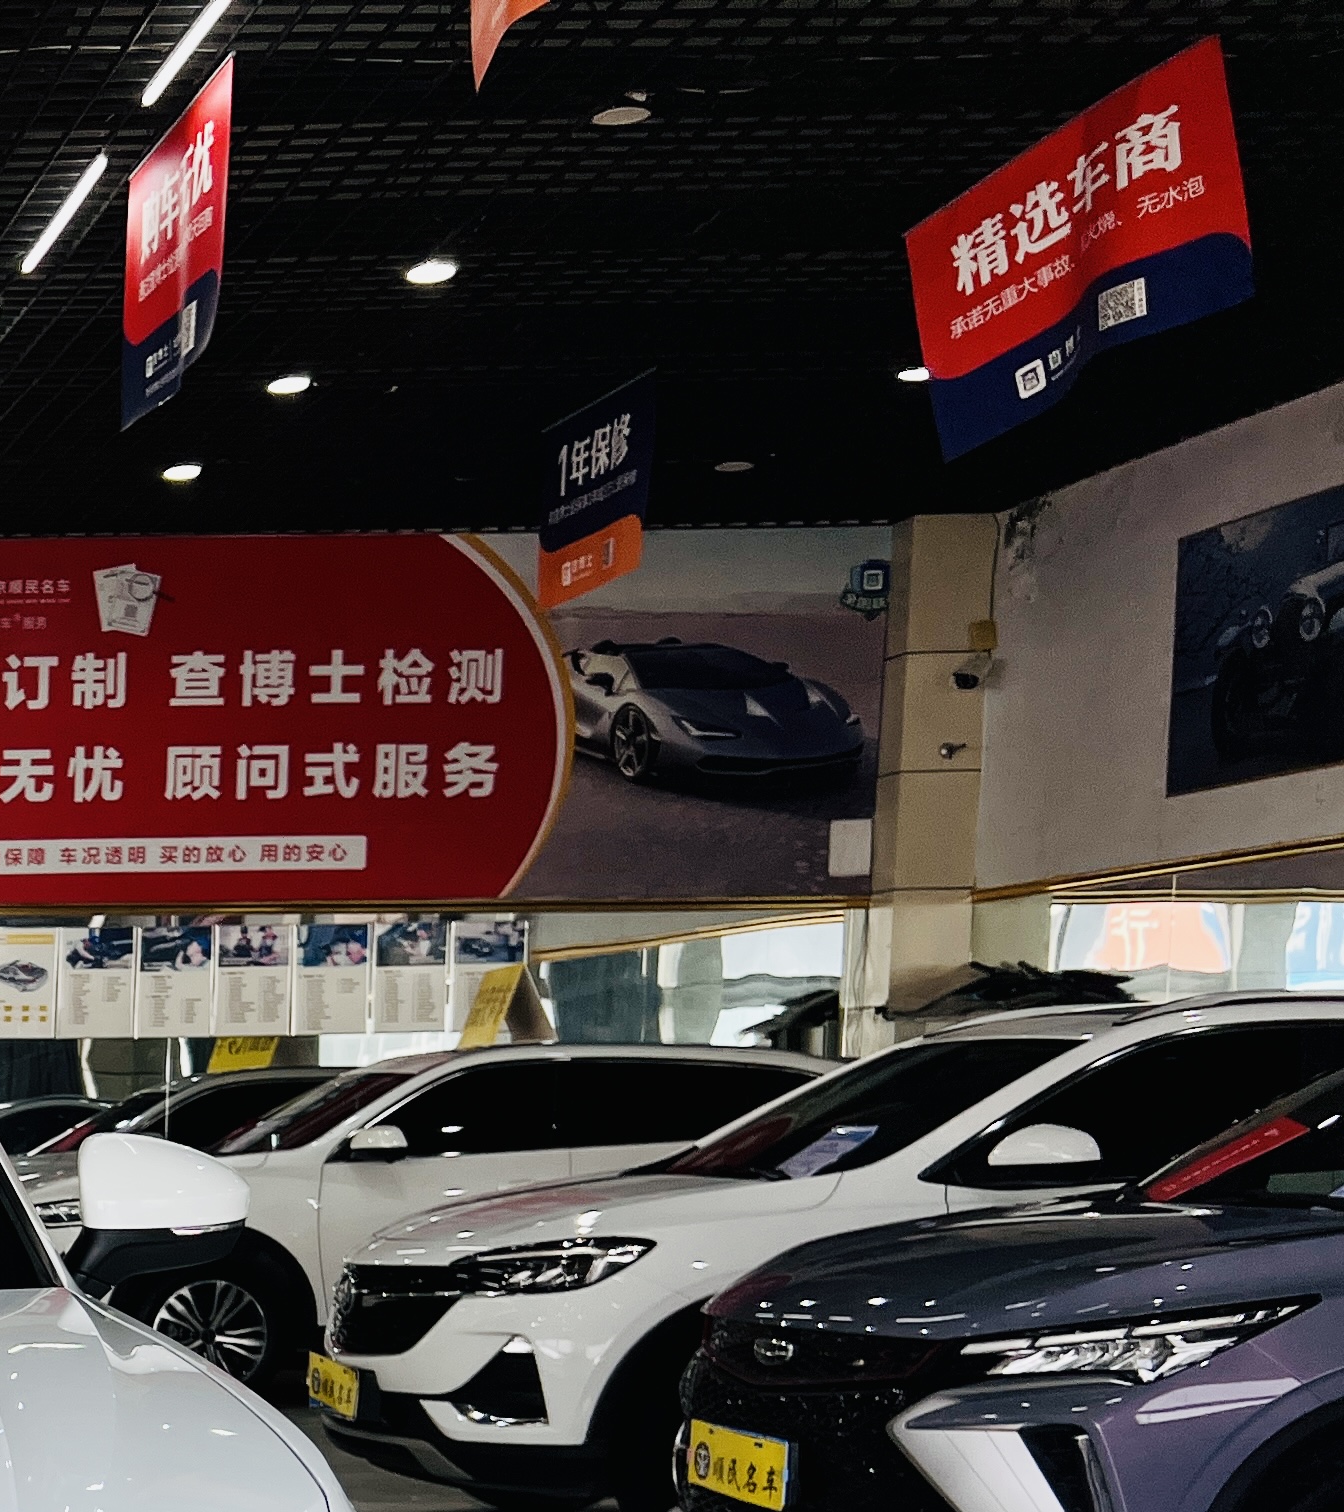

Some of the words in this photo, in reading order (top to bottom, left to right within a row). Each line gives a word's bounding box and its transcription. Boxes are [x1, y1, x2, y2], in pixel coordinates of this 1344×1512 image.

[951, 104, 1182, 297] 精选车商
[1136, 175, 1205, 218] 无水泡
[558, 412, 631, 497] 1年保修
[168, 648, 506, 708] 查博士检测
[164, 742, 501, 802] 顾问式服务
[59, 846, 148, 868] 车况透明
[159, 845, 248, 867] 买的放心
[259, 843, 349, 865] 用的安心
[714, 1456, 778, 1502] 顺民名车
